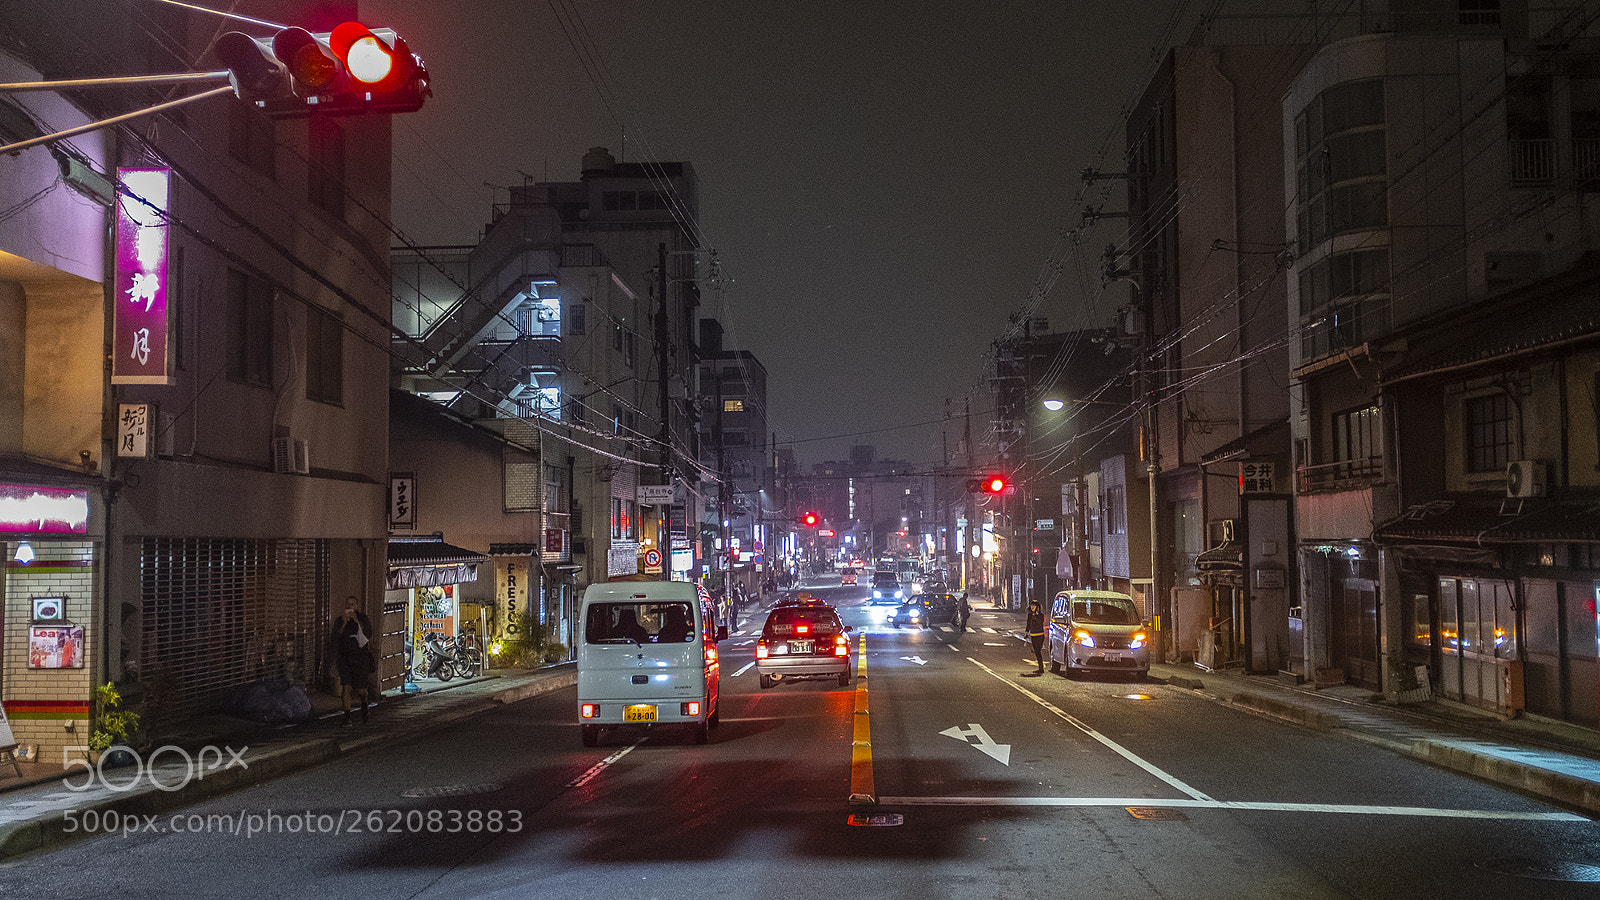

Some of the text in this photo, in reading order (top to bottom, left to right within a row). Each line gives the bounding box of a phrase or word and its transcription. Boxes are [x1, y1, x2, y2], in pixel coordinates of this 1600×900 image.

[121, 408, 138, 452] 新月
[1244, 463, 1273, 477] 今井
[1244, 477, 1273, 491] 歯科
[395, 480, 409, 520] ウエダ
[506, 562, 518, 635] FRESCO
